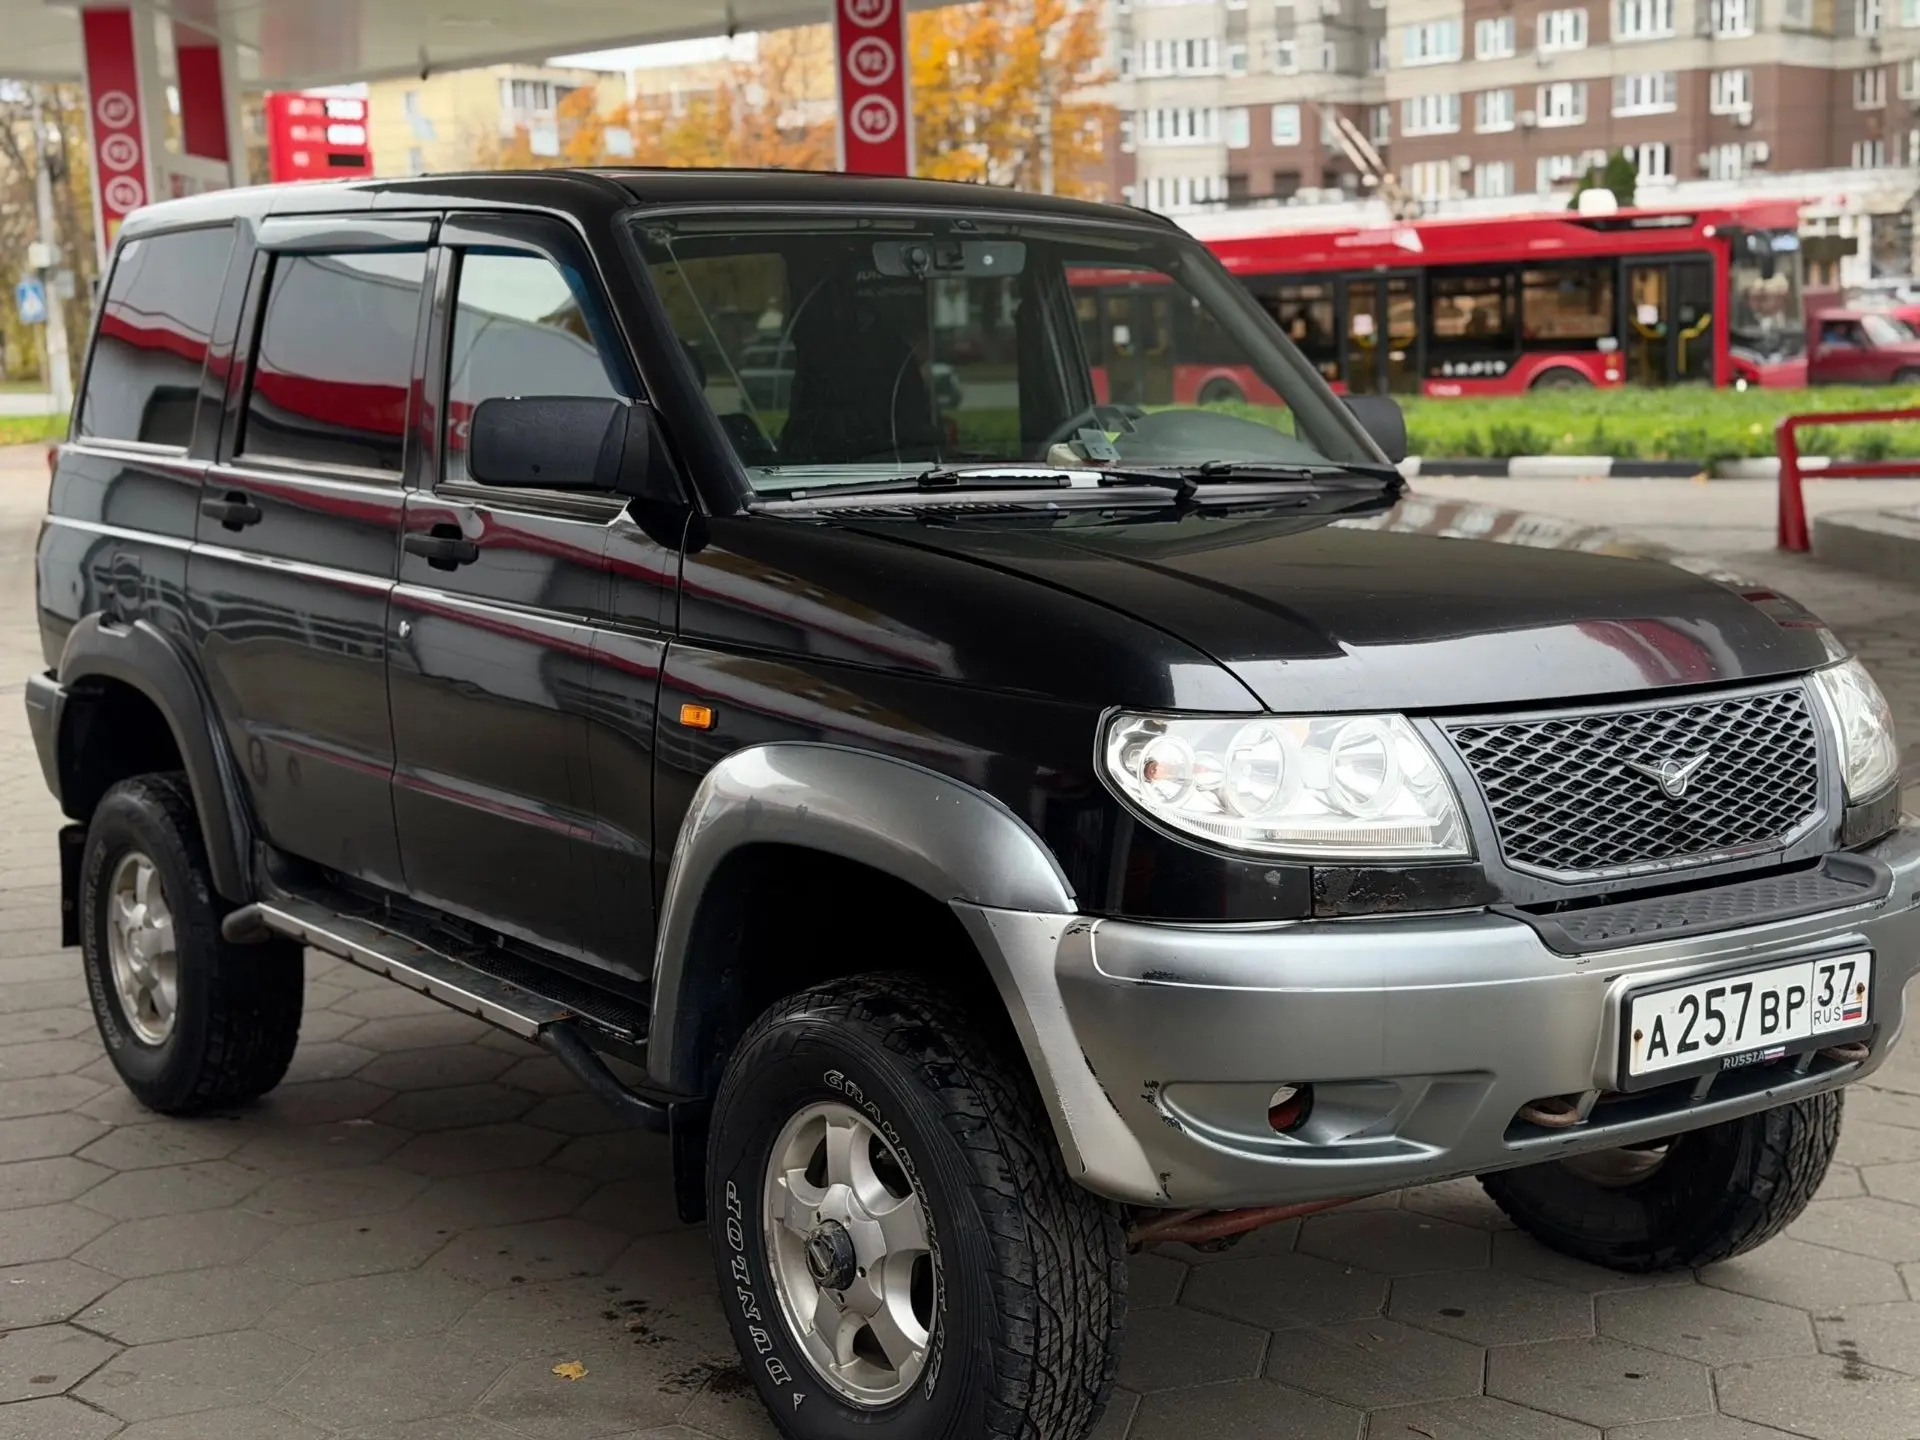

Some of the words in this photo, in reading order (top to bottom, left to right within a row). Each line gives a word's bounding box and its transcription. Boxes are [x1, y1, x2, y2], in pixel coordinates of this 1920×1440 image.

[1817, 961, 1856, 1008] 37
[1813, 1006, 1842, 1026] RUS
[1723, 1050, 1765, 1070] RUSSIA
[725, 1180, 792, 1386] DUNLOP
